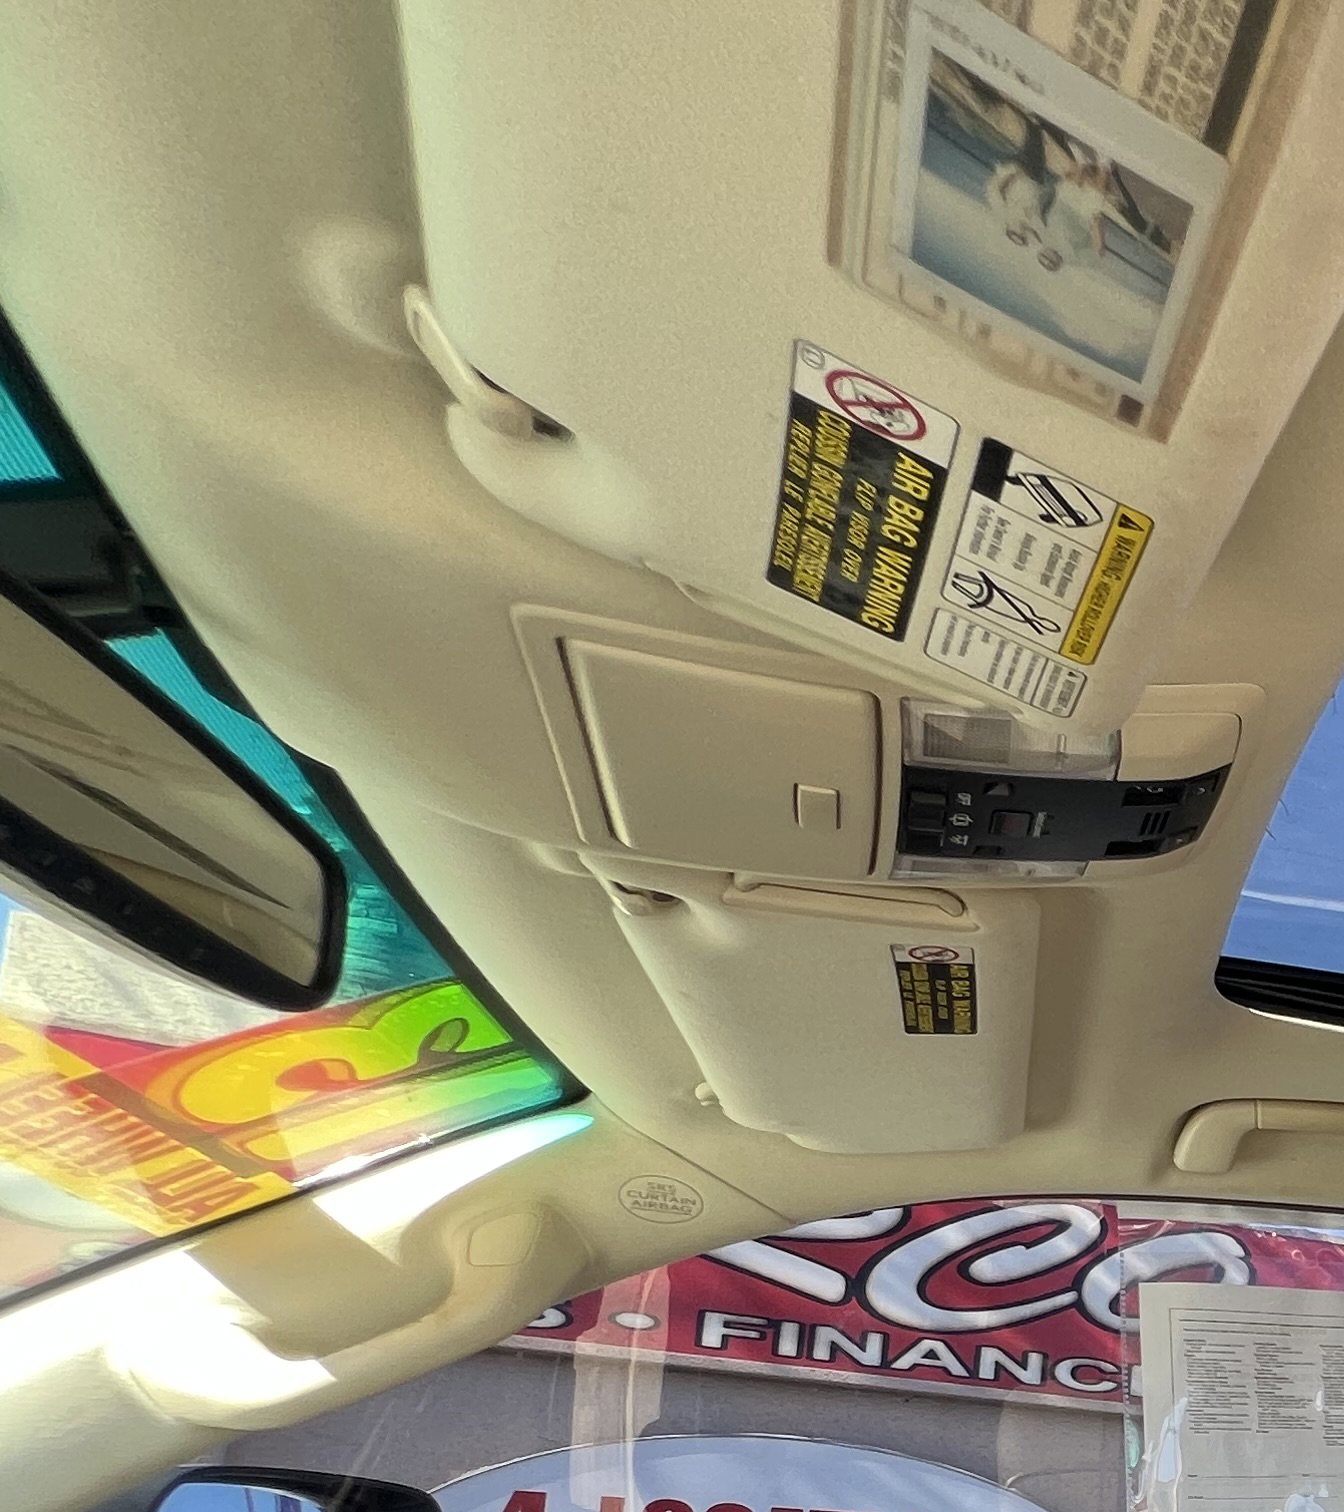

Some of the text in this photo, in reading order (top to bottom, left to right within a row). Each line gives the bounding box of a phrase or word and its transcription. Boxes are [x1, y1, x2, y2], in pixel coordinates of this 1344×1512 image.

[786, 418, 812, 480] REPLIER
[783, 479, 803, 501] LE
[839, 476, 876, 583] FLIP VISOR OVER
[860, 450, 935, 635] AIR BAG WARNING
[626, 1190, 697, 1206] CURTAIN
[631, 1200, 693, 1213] AIRBAG
